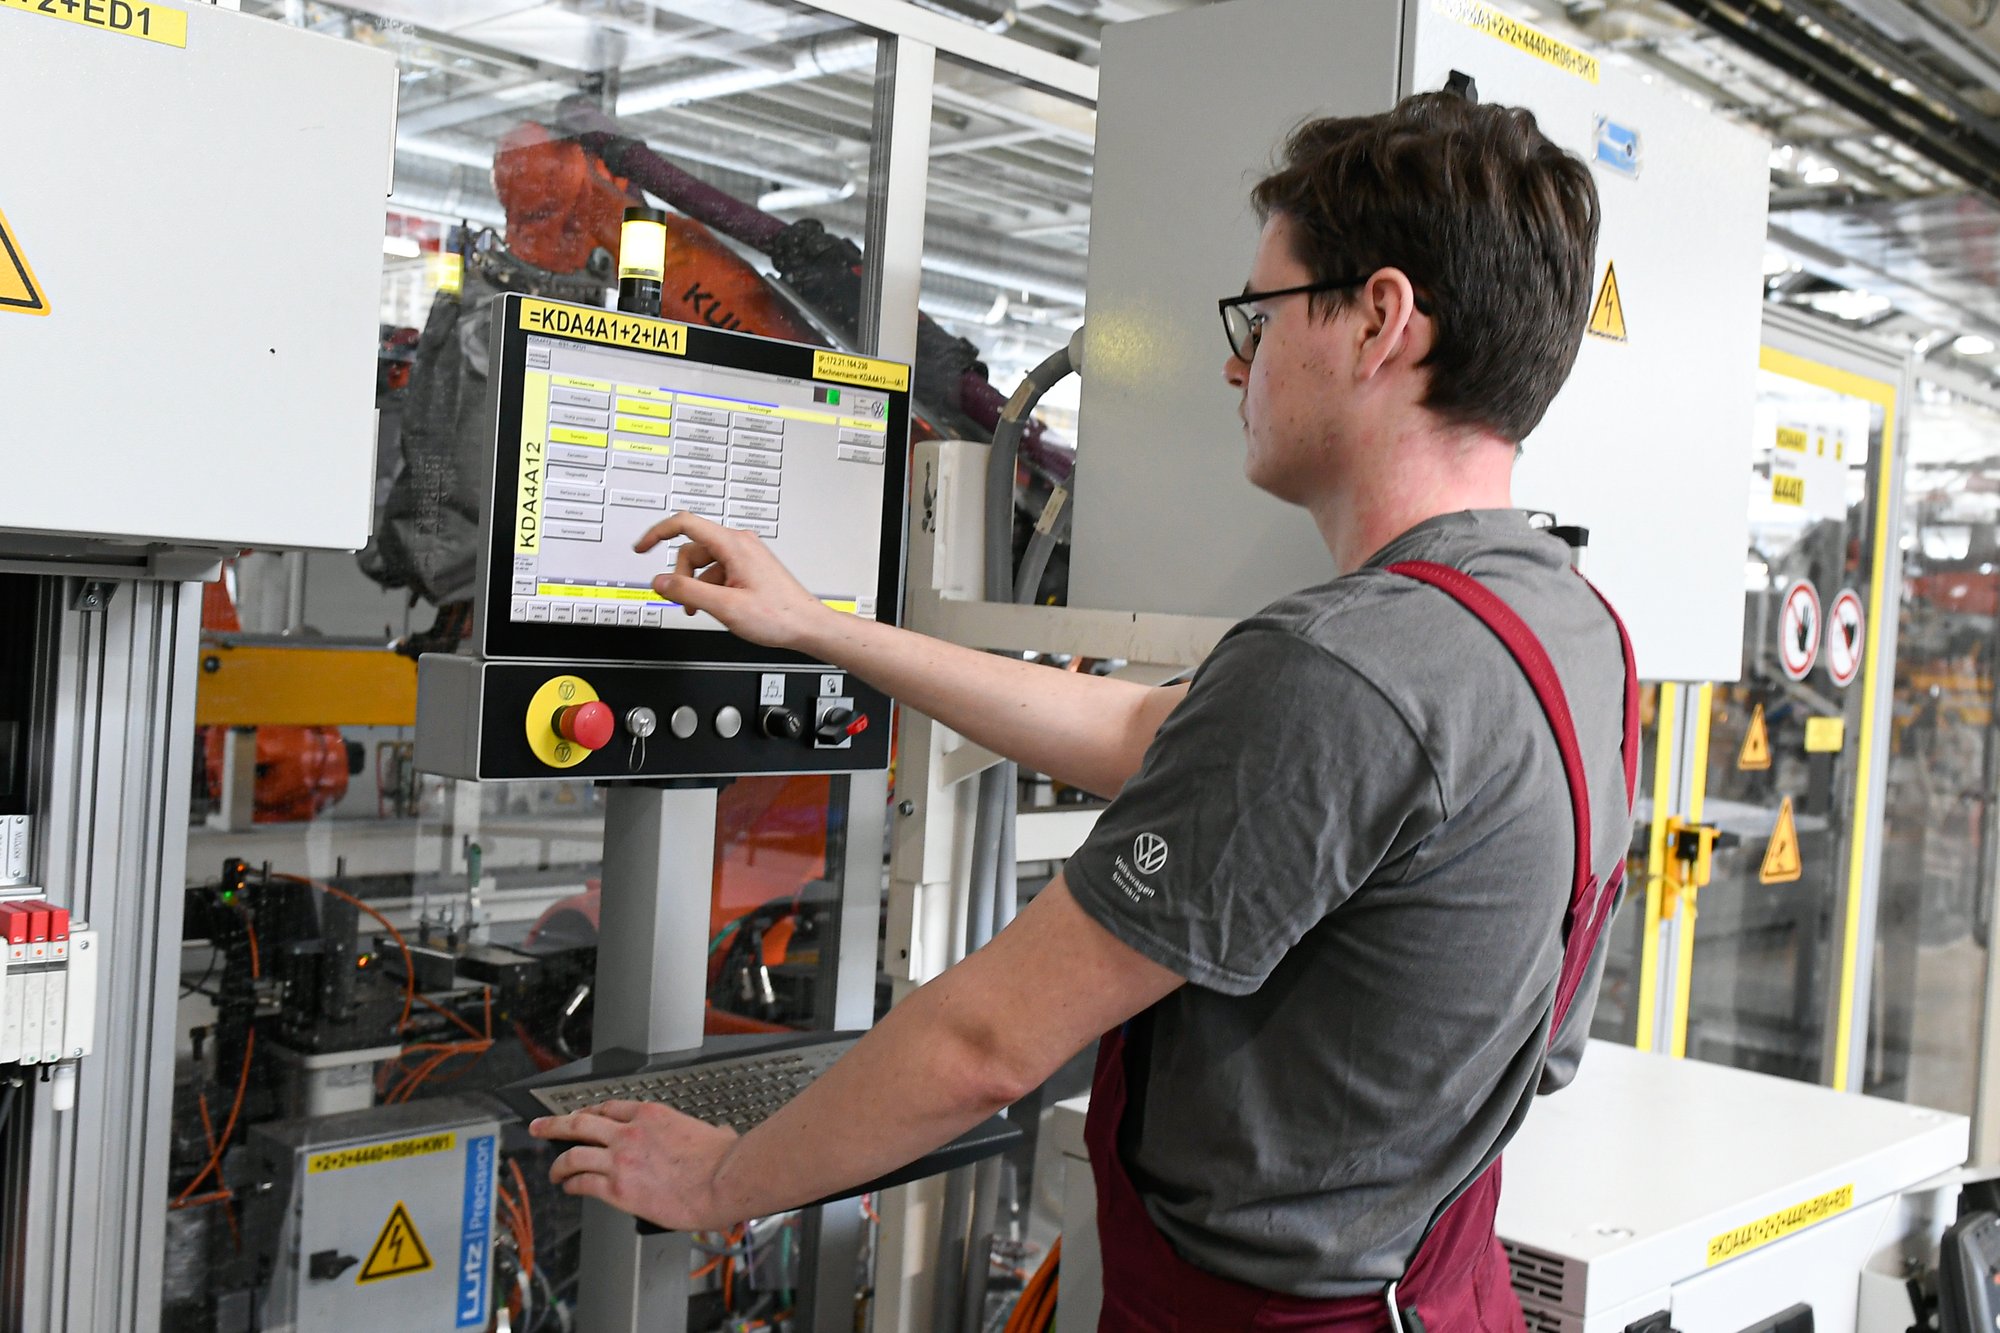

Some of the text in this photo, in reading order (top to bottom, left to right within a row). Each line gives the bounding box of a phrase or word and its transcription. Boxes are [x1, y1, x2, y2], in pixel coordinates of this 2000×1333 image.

[530, 308, 679, 351] =KDA4A1+2+IA1
[520, 442, 541, 548] KDA4A12
[1112, 871, 1140, 902] Slovakia
[1115, 855, 1155, 898] Volkswagen
